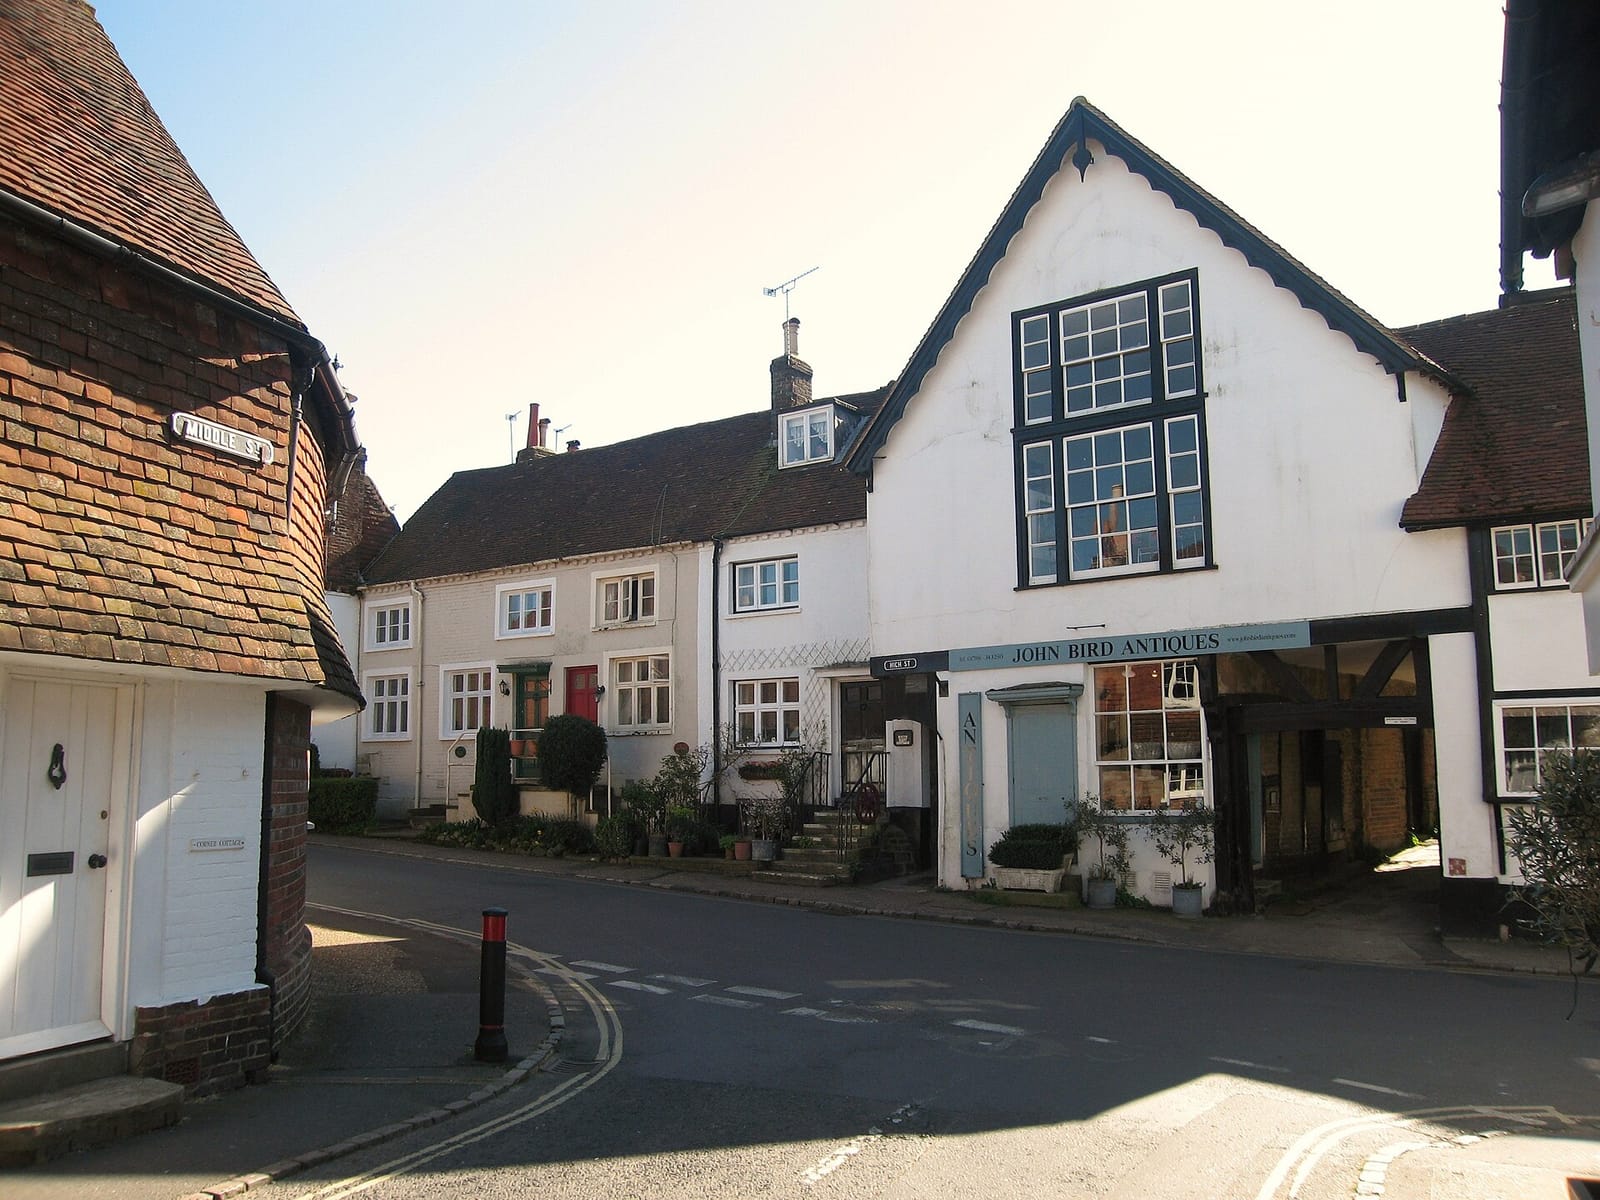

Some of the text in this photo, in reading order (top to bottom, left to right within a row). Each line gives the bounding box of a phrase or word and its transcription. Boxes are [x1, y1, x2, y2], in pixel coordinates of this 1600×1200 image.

[186, 420, 236, 449] MIDDLE
[1012, 645, 1060, 663] JOHN
[1068, 641, 1114, 659] BIRD
[1121, 633, 1220, 655] ANTIQUES
